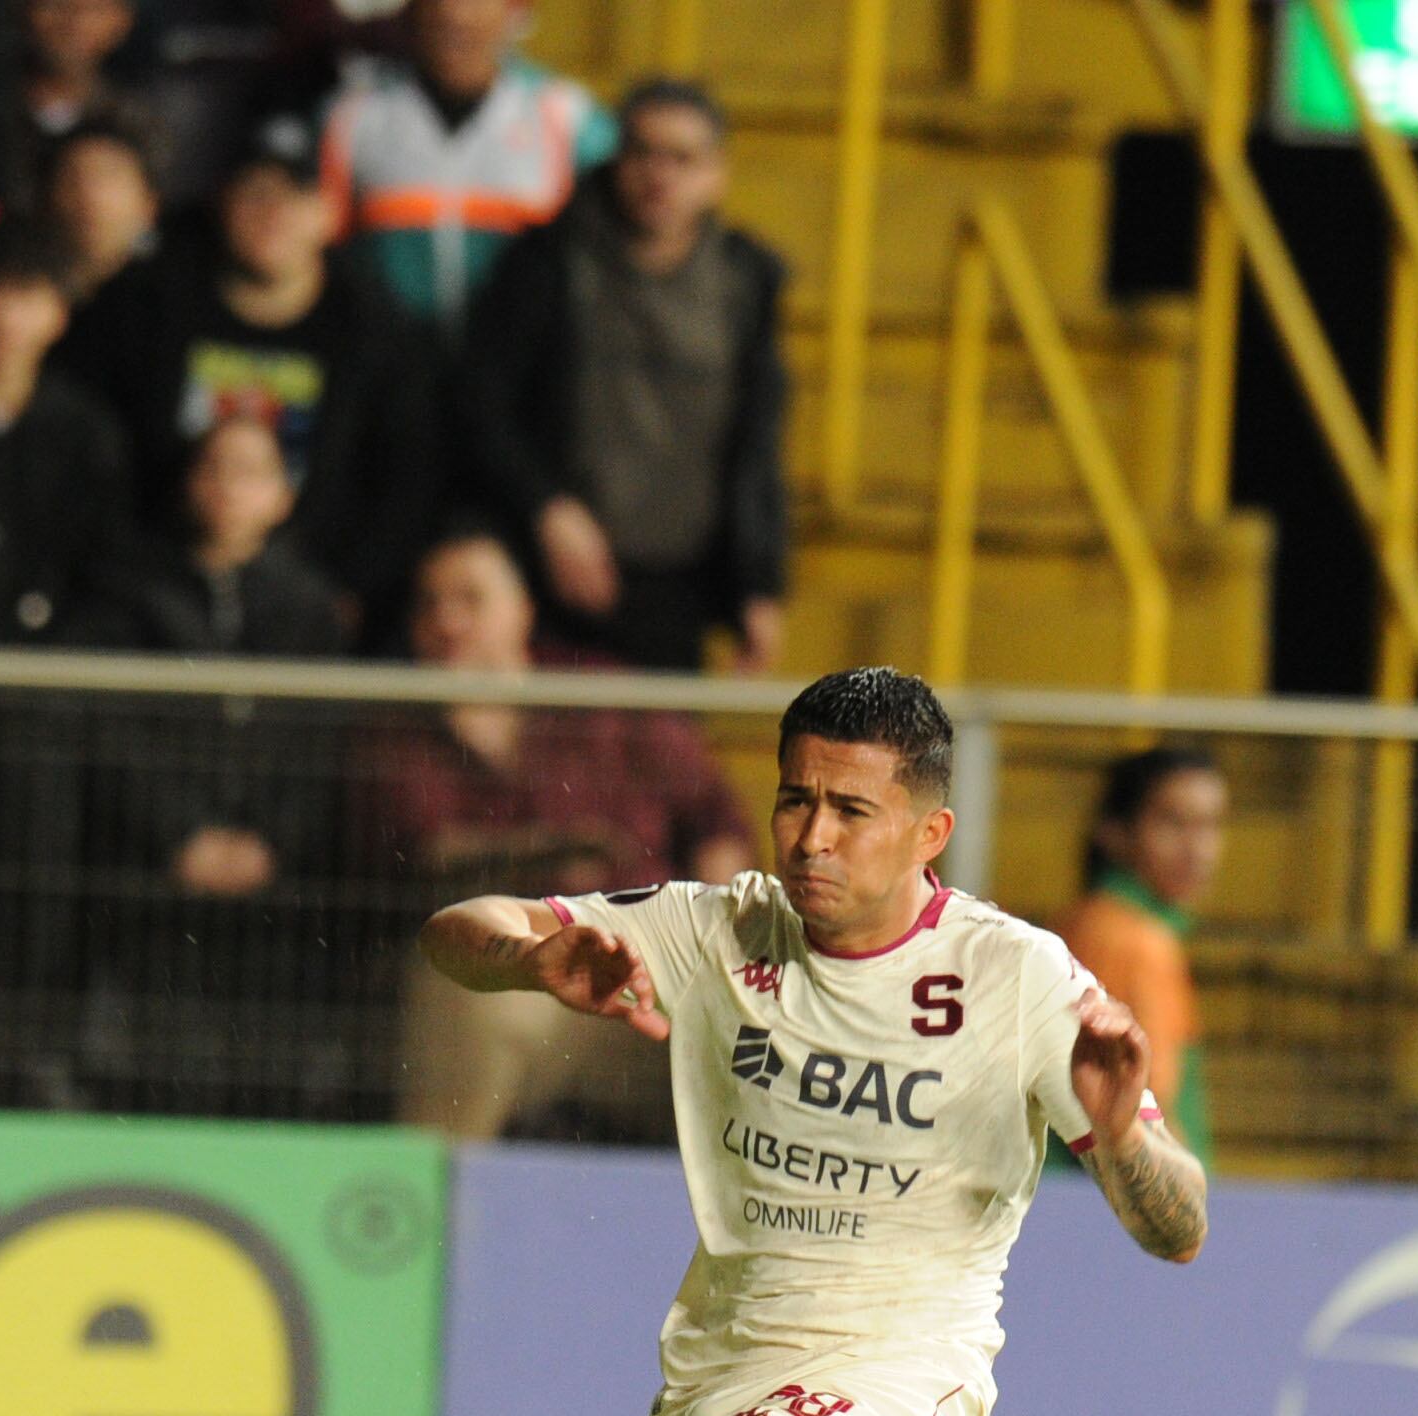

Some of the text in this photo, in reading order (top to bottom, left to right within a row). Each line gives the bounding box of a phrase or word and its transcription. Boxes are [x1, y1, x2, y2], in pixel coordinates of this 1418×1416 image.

[910, 974, 964, 1037] S
[798, 1052, 943, 1129] BAC
[722, 1117, 921, 1198] LIBERTY
[743, 1197, 868, 1239] OMNILIFE
